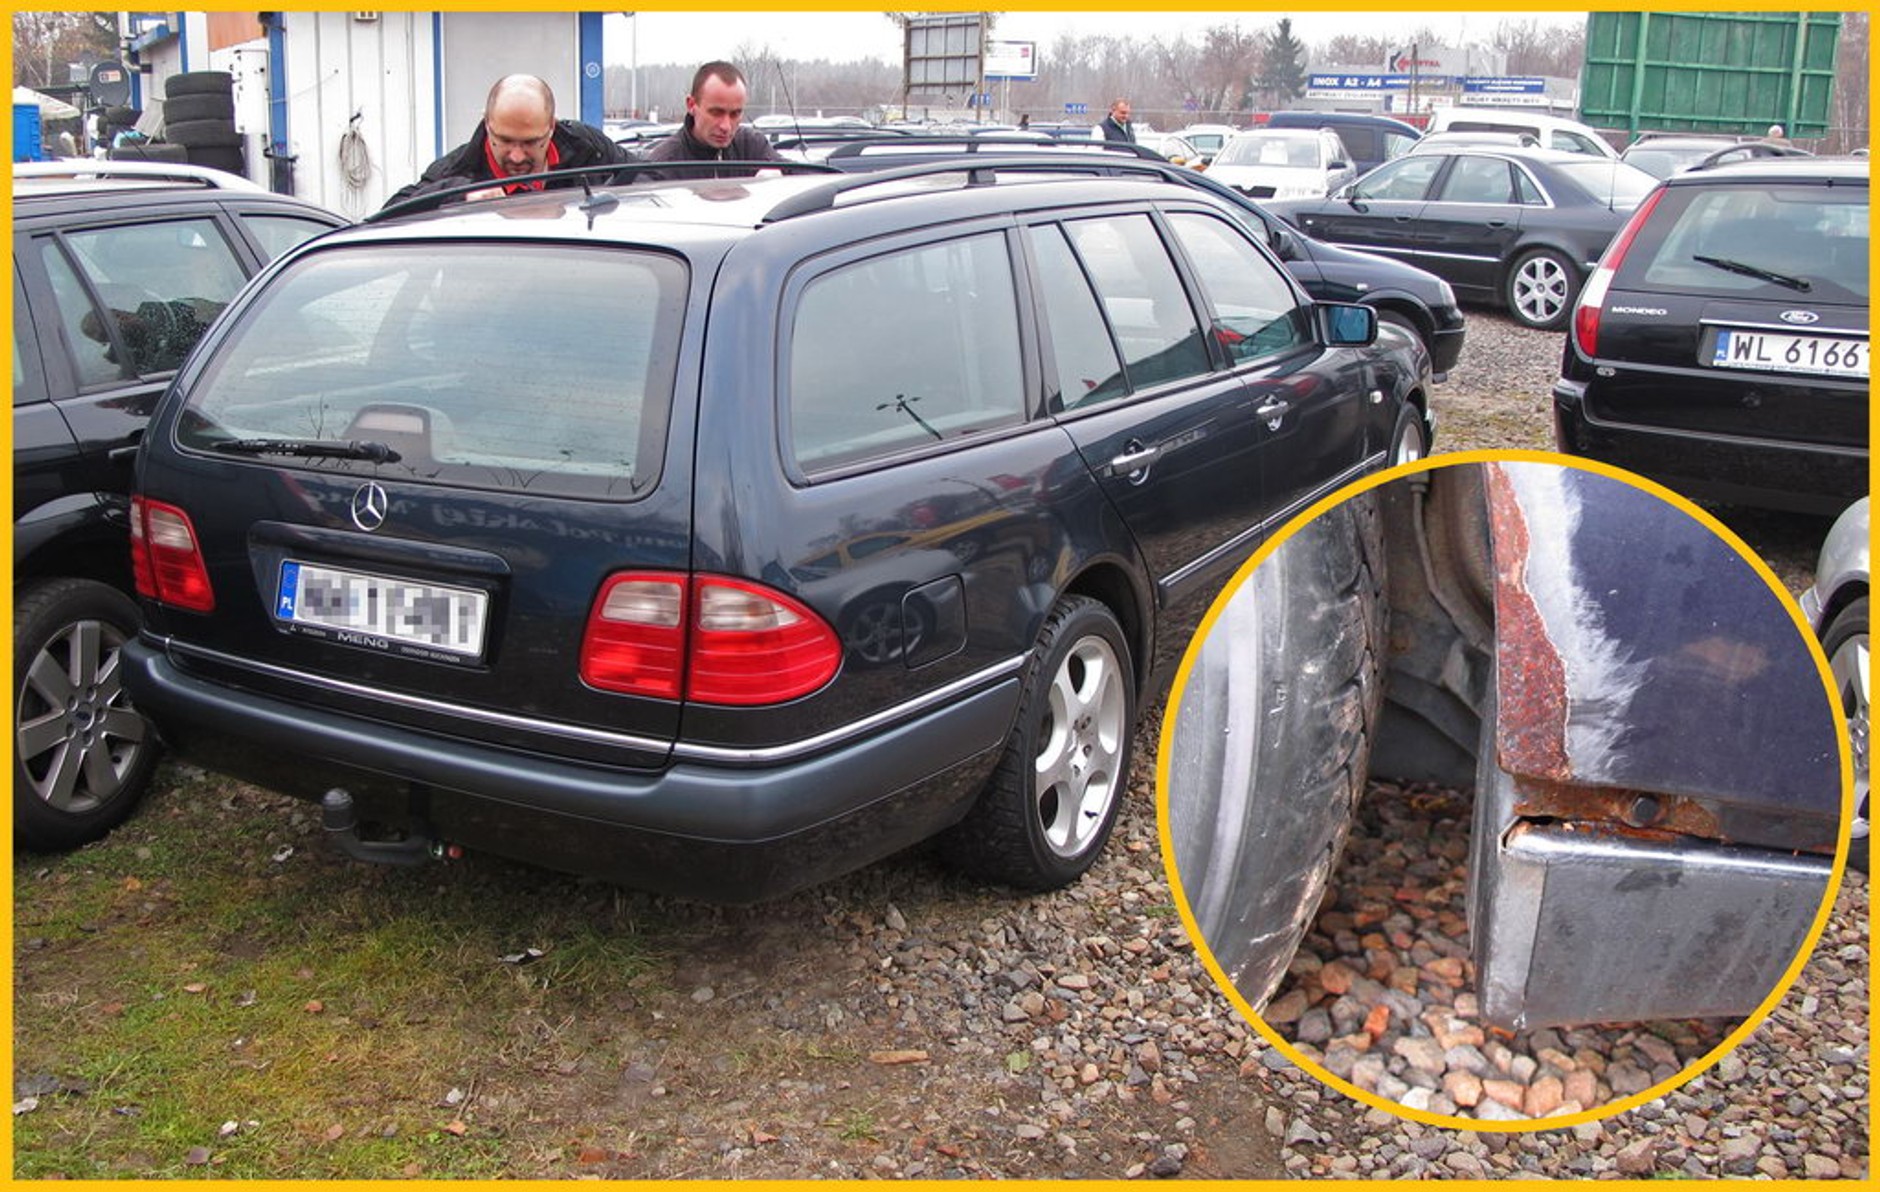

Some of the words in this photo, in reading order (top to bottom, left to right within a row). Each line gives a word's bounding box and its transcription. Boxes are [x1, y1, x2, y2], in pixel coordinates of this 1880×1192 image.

[1312, 77, 1340, 87] INOX
[1366, 77, 1382, 88] A4
[1611, 305, 1668, 316] MONDEO
[1734, 335, 1771, 361] WL
[1785, 338, 1869, 368] 6166
[282, 596, 293, 610] PL
[337, 631, 389, 650] MENG
